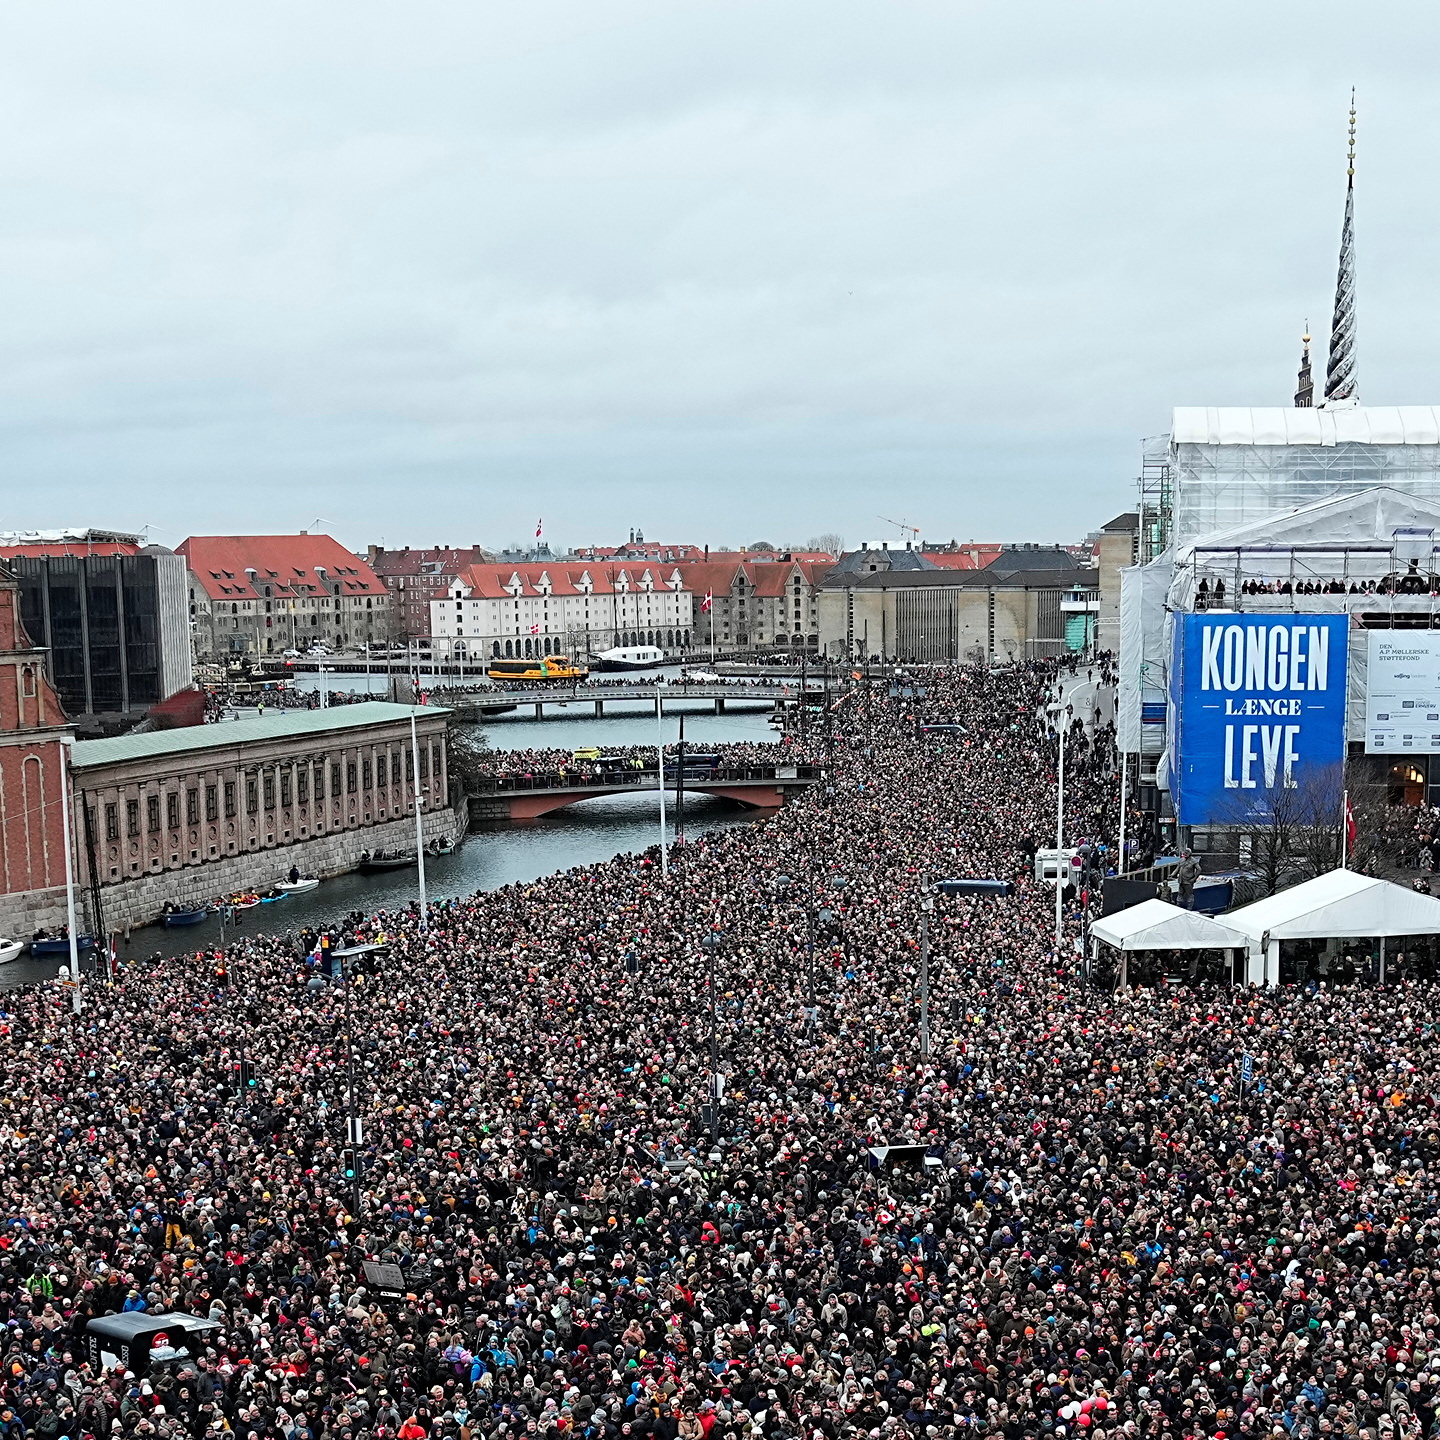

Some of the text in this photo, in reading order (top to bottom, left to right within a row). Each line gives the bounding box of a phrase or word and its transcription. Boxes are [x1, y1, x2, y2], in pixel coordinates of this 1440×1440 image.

[1201, 625, 1329, 691] KONGEN
[1225, 699, 1302, 715] LÆNGE
[1224, 725, 1300, 788] LEVE
[1131, 840, 1138, 848] P
[89, 1336, 97, 1370] COFFEE
